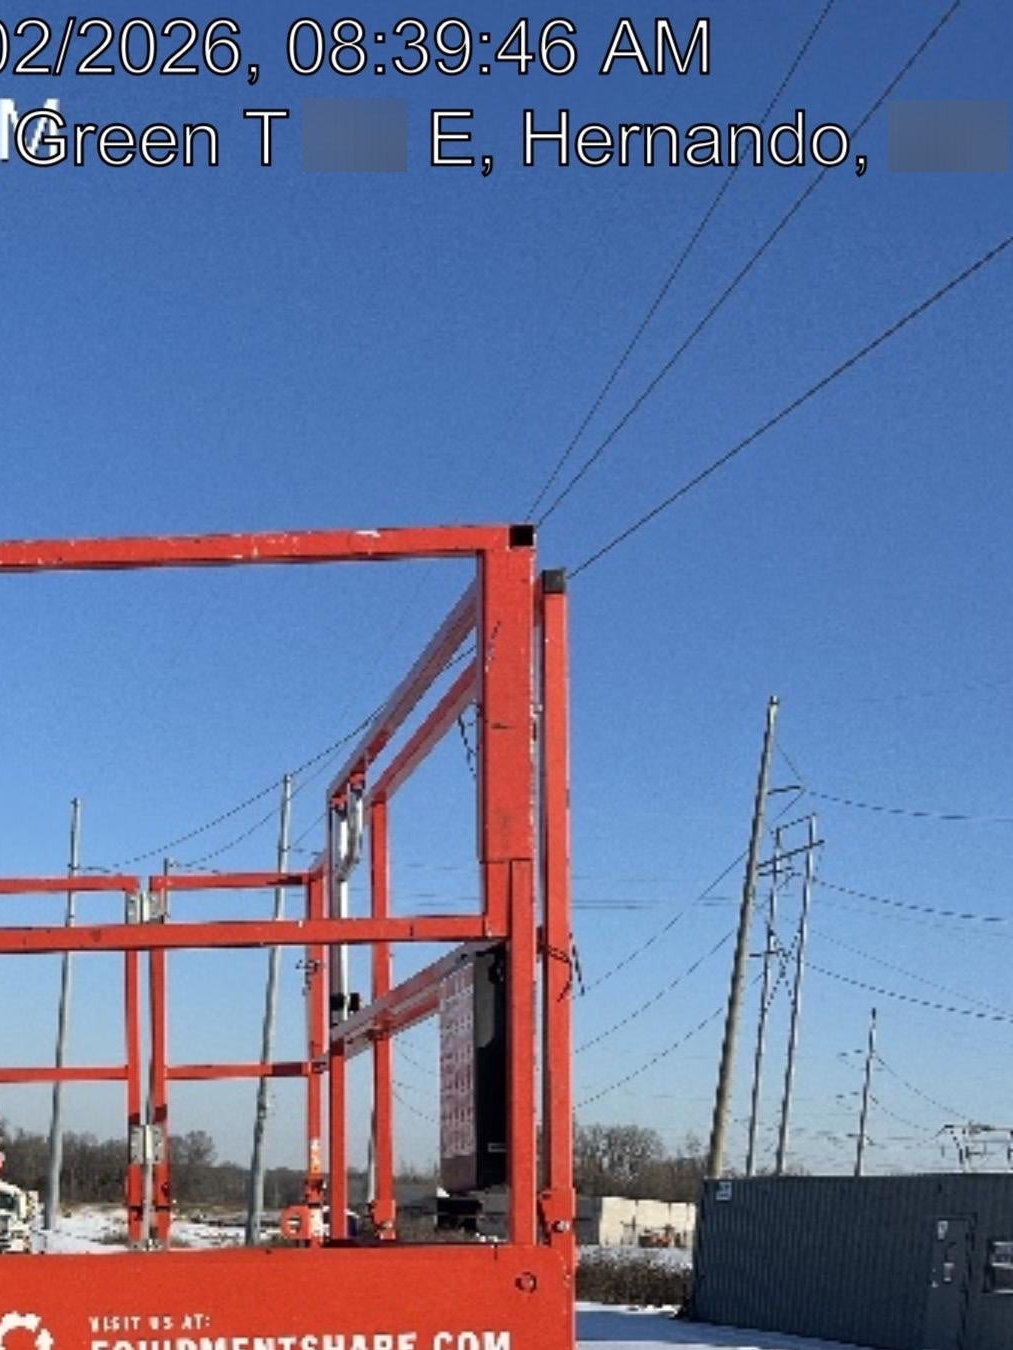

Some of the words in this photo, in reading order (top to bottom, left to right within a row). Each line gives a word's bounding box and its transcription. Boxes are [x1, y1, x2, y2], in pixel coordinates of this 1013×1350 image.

[89, 1315, 141, 1333] VISIT
[149, 1314, 174, 1331] US
[181, 1313, 211, 1331] AT:
